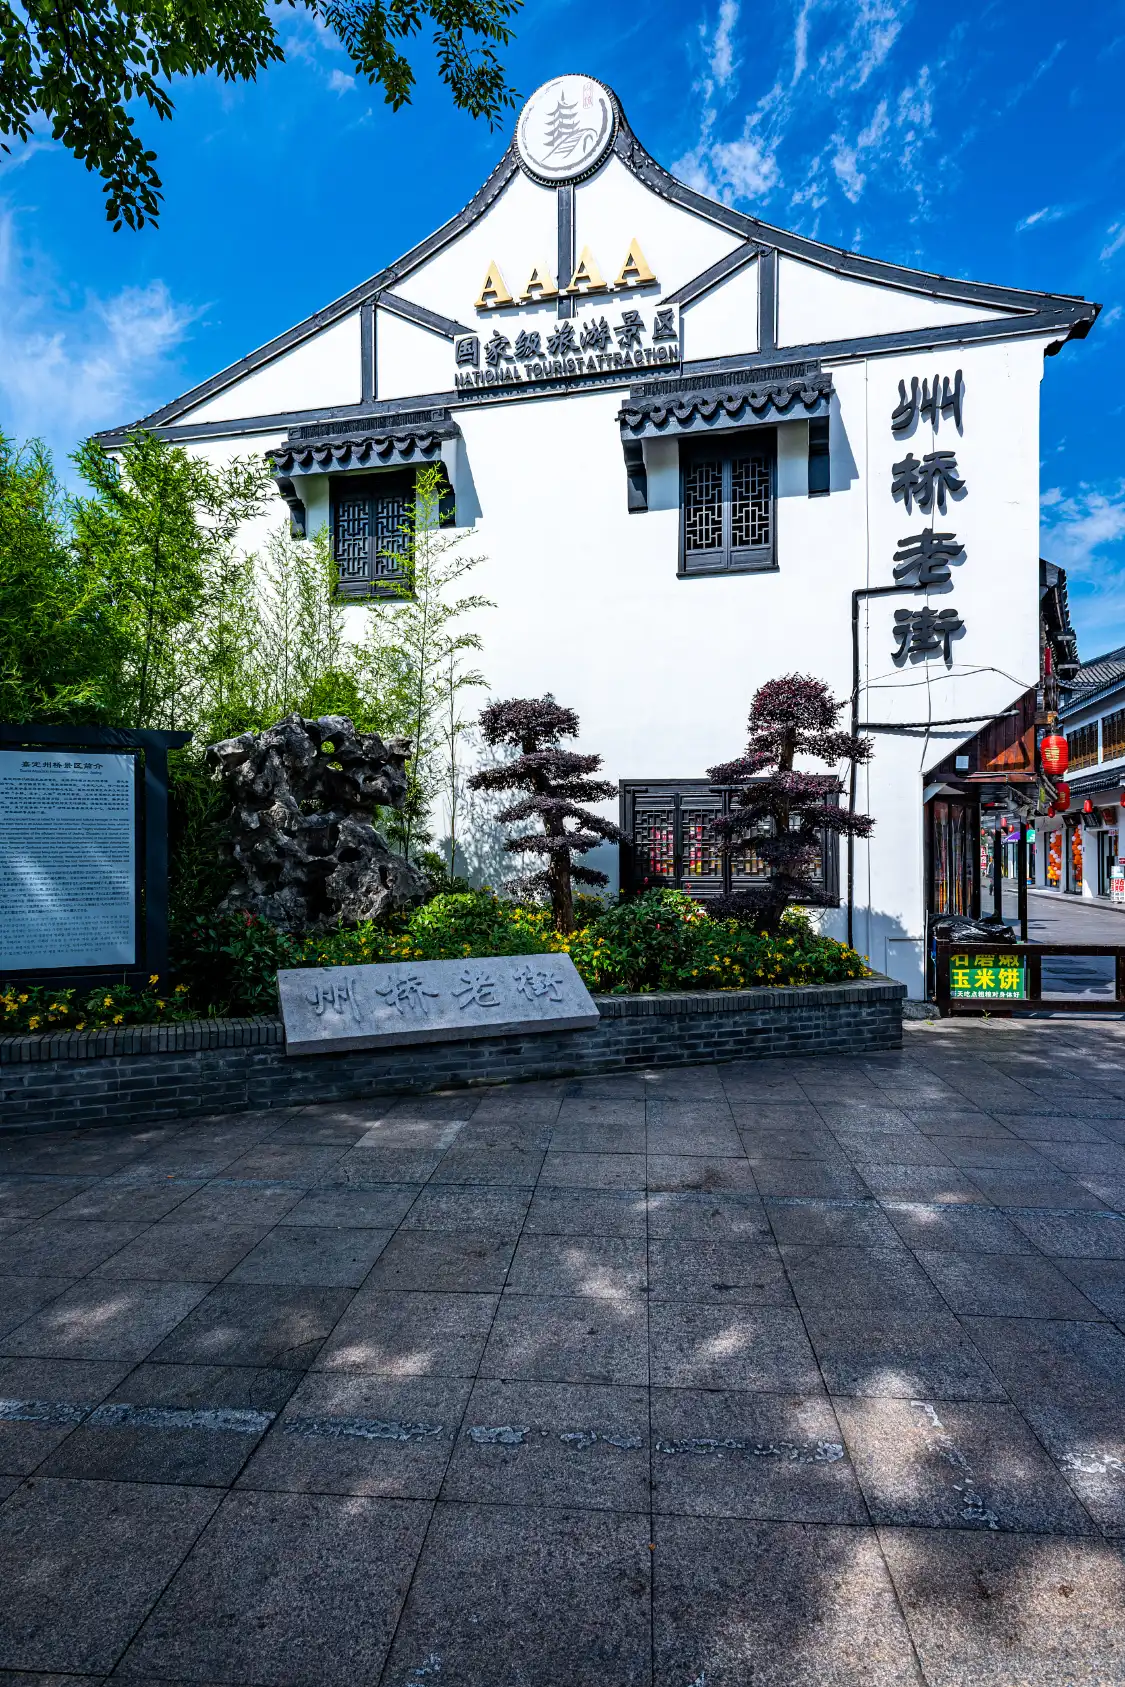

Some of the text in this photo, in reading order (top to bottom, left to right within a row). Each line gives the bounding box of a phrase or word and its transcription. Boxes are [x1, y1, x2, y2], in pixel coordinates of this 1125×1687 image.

[455, 308, 678, 366] 国家级旅游景区
[454, 344, 679, 387] NATIONAL TOURIST ATTRACTION
[891, 369, 966, 663] 州桥老街
[950, 968, 1021, 989] 玉米饼
